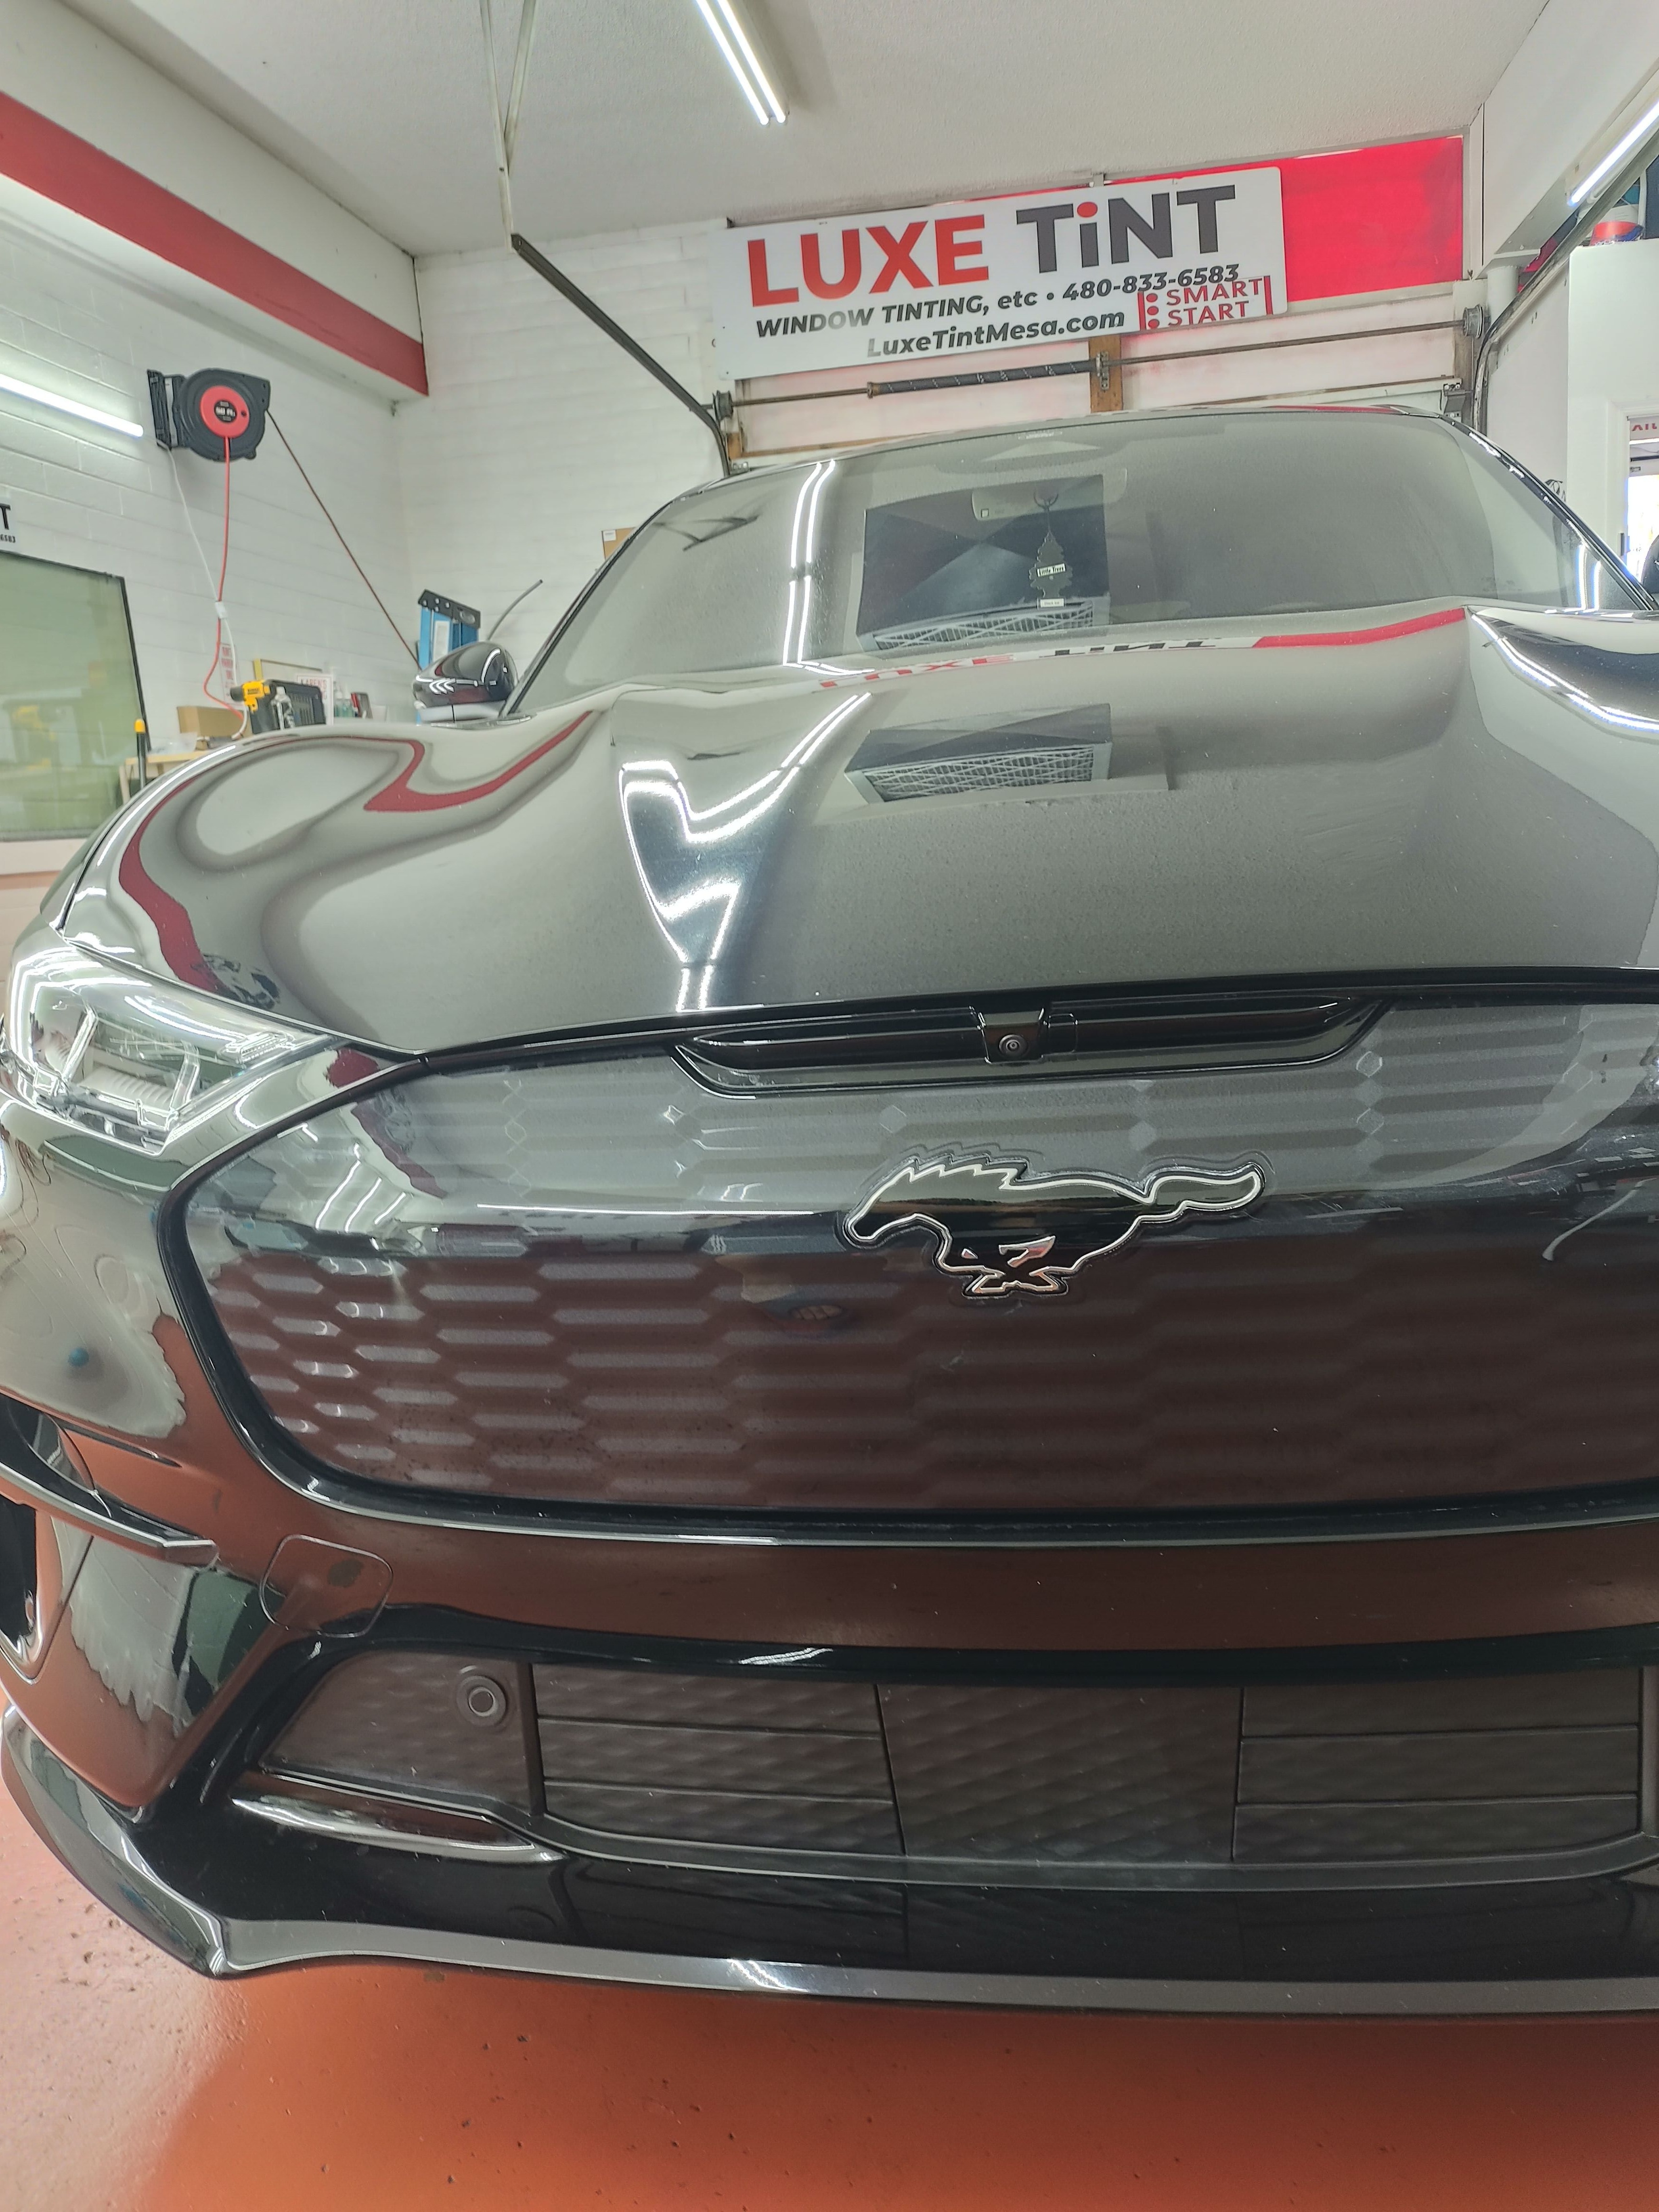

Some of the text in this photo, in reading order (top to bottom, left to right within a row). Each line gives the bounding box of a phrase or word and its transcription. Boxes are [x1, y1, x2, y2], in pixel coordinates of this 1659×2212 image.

[747, 214, 989, 307] LUXE
[756, 264, 1239, 338] WINDOW TINTING, etc 480-833-6583
[1166, 277, 1262, 306] SMART
[1167, 300, 1250, 328] START
[867, 311, 1125, 357] LuxeTintMesa.com
